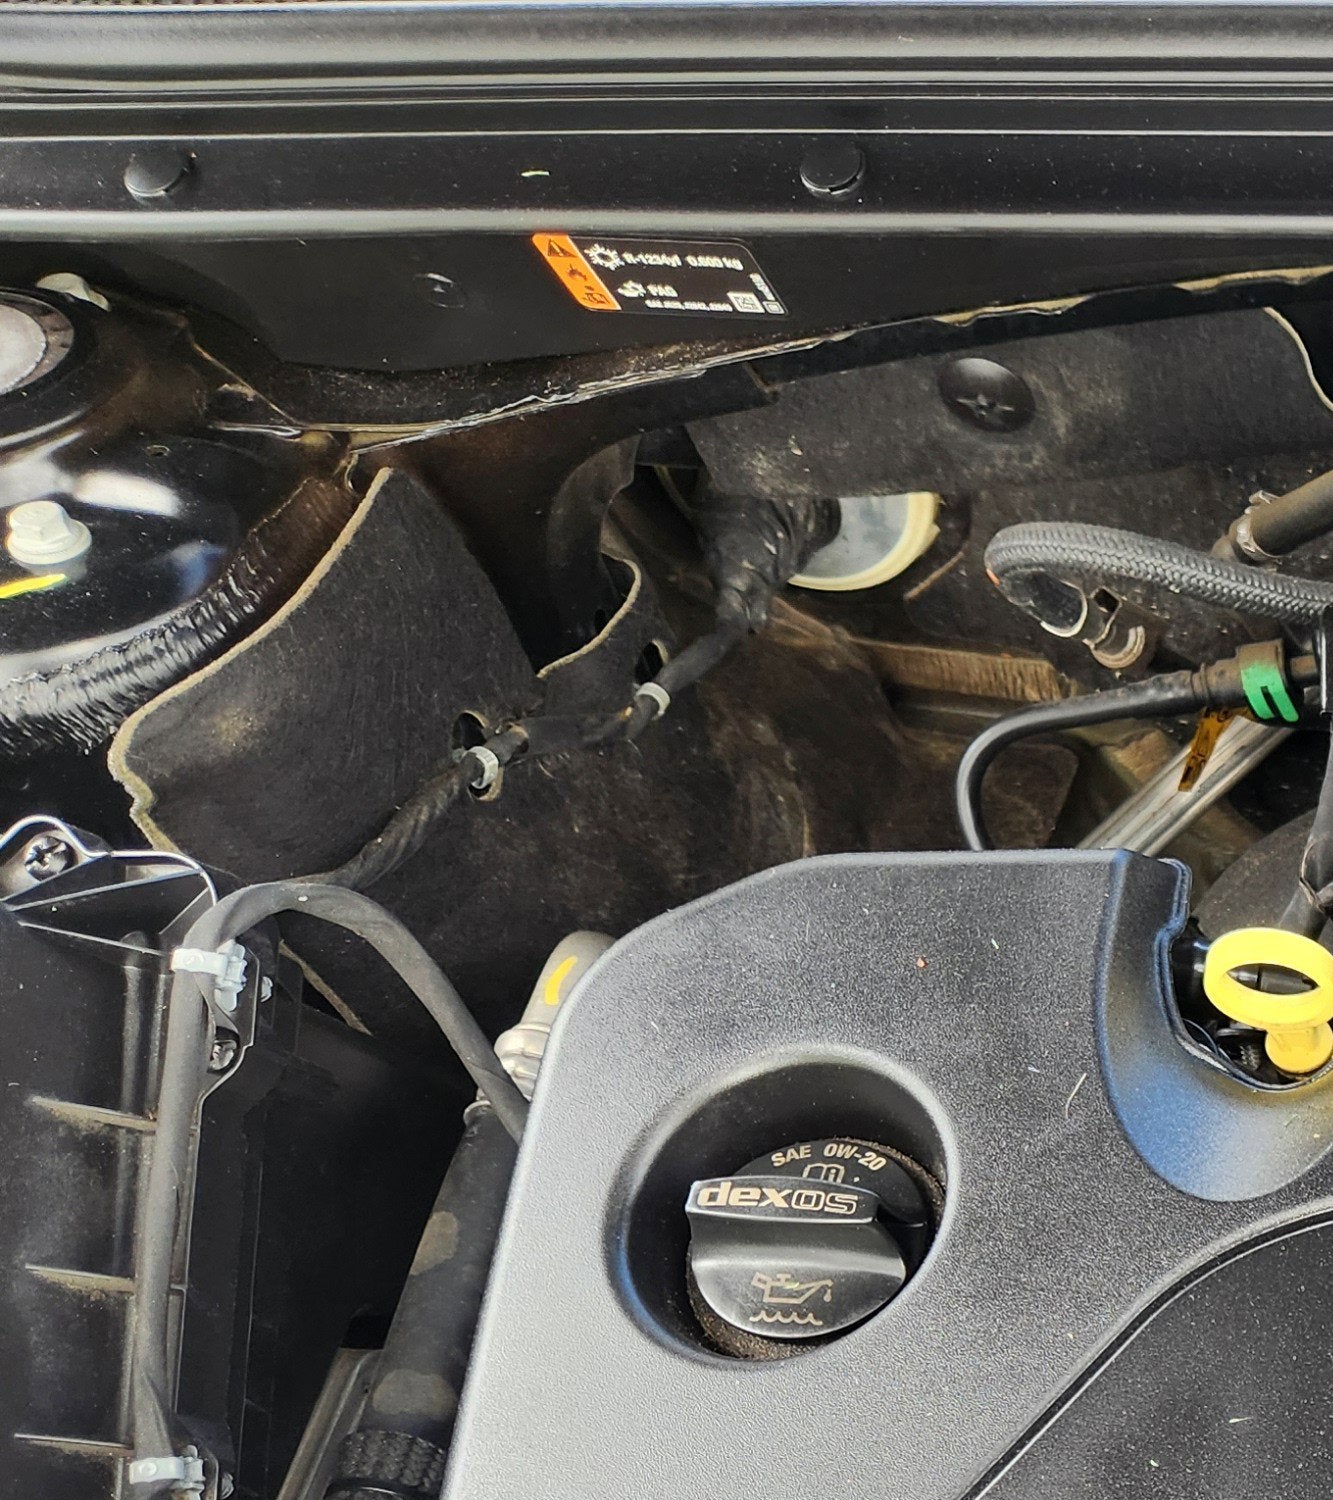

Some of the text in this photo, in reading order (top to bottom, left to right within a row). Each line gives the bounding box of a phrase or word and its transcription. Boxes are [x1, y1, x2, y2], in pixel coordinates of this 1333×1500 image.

[771, 1142, 887, 1172] SAE 0W-20
[697, 1182, 860, 1215] dexos
